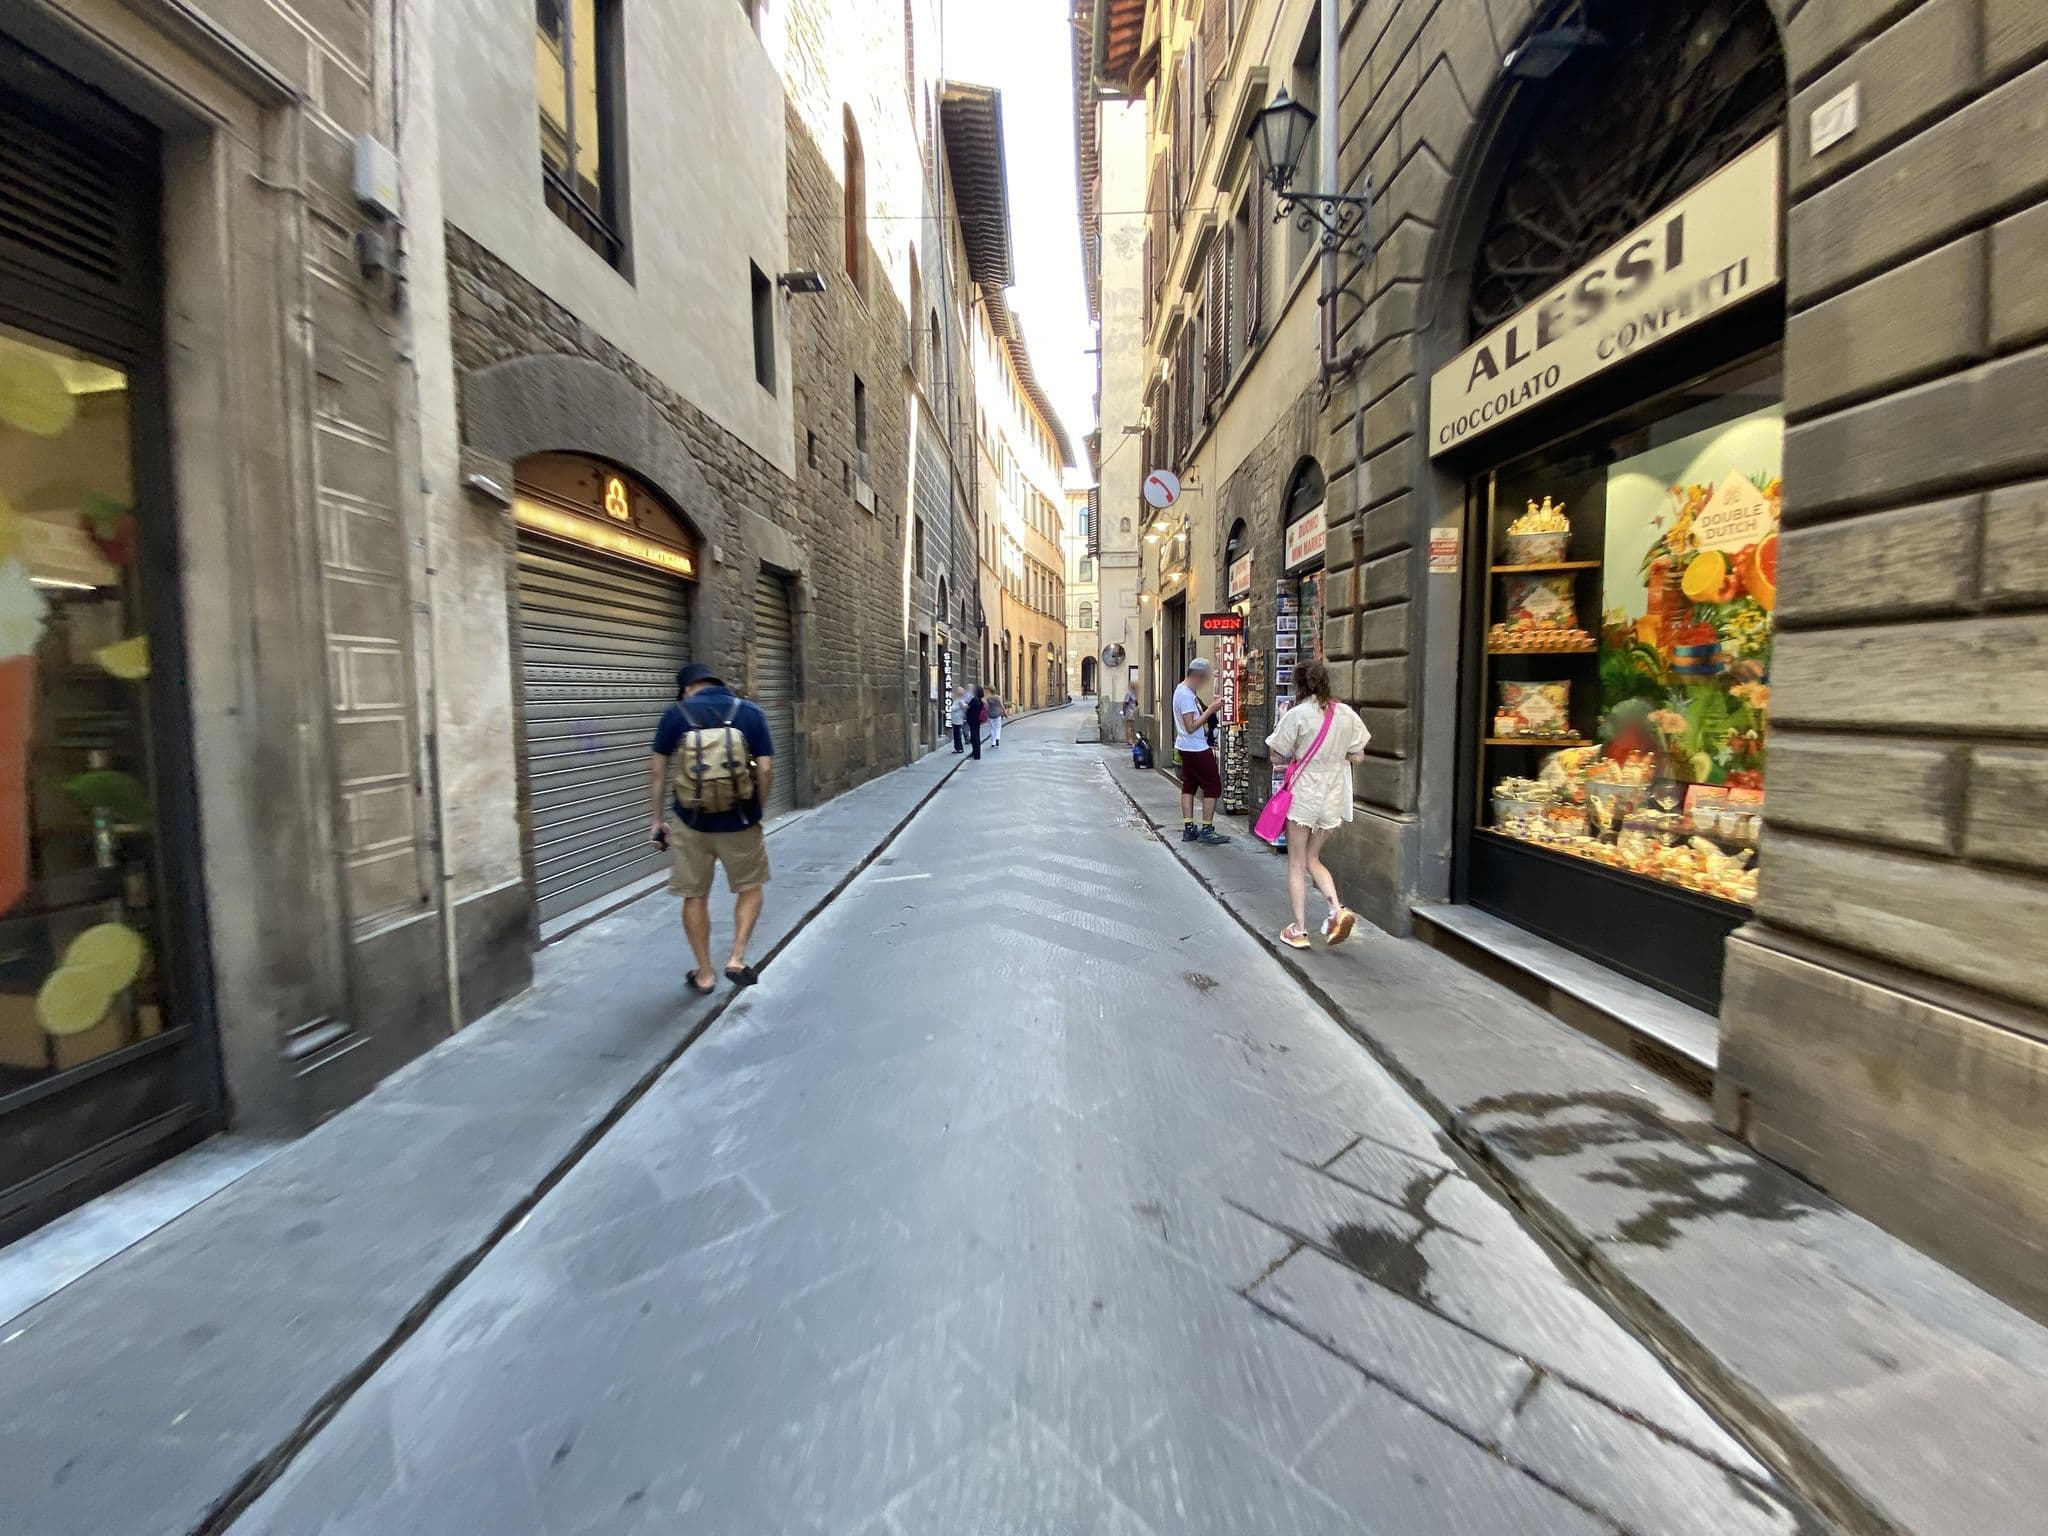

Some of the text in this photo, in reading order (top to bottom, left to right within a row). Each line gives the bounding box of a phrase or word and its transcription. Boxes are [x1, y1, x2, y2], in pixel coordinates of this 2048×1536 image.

[1464, 212, 1685, 394] ALESSI
[1438, 364, 1561, 445] CIOCCOLATO
[1701, 503, 1763, 528] DOUBLE
[1705, 519, 1757, 540] DUTCH
[1203, 618, 1241, 630] OPEN
[943, 652, 953, 728] STEAK HOUSE
[1222, 634, 1236, 722] MINIMARKET
